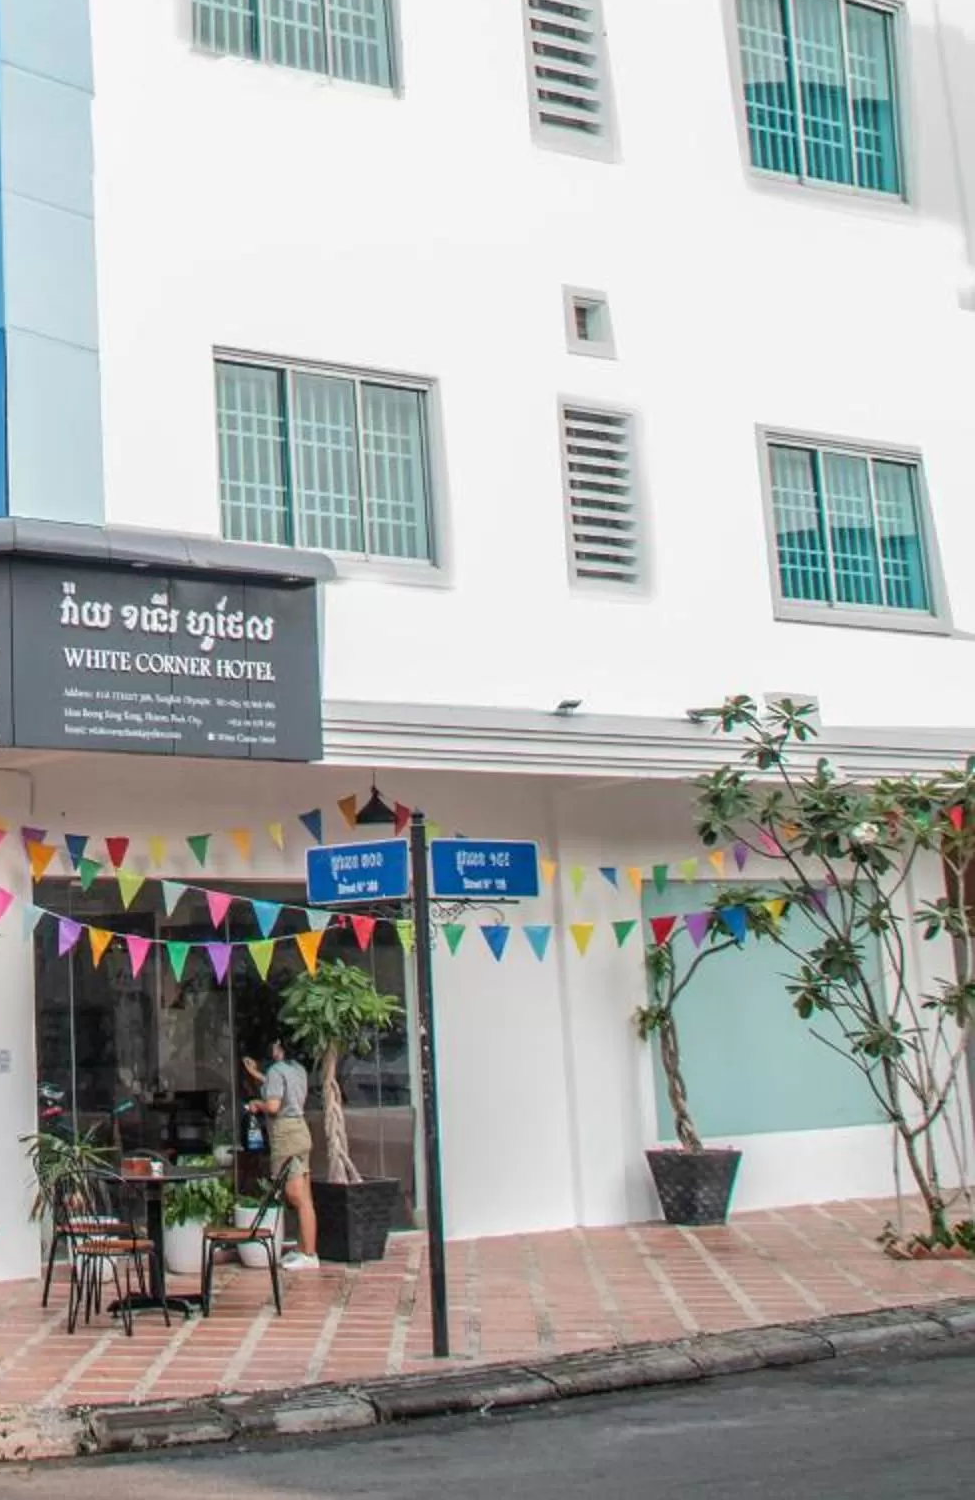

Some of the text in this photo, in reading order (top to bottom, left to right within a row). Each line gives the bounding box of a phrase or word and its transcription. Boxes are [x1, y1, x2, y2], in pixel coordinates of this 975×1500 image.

[64, 647, 276, 681] WHITE CORNER HOTEL
